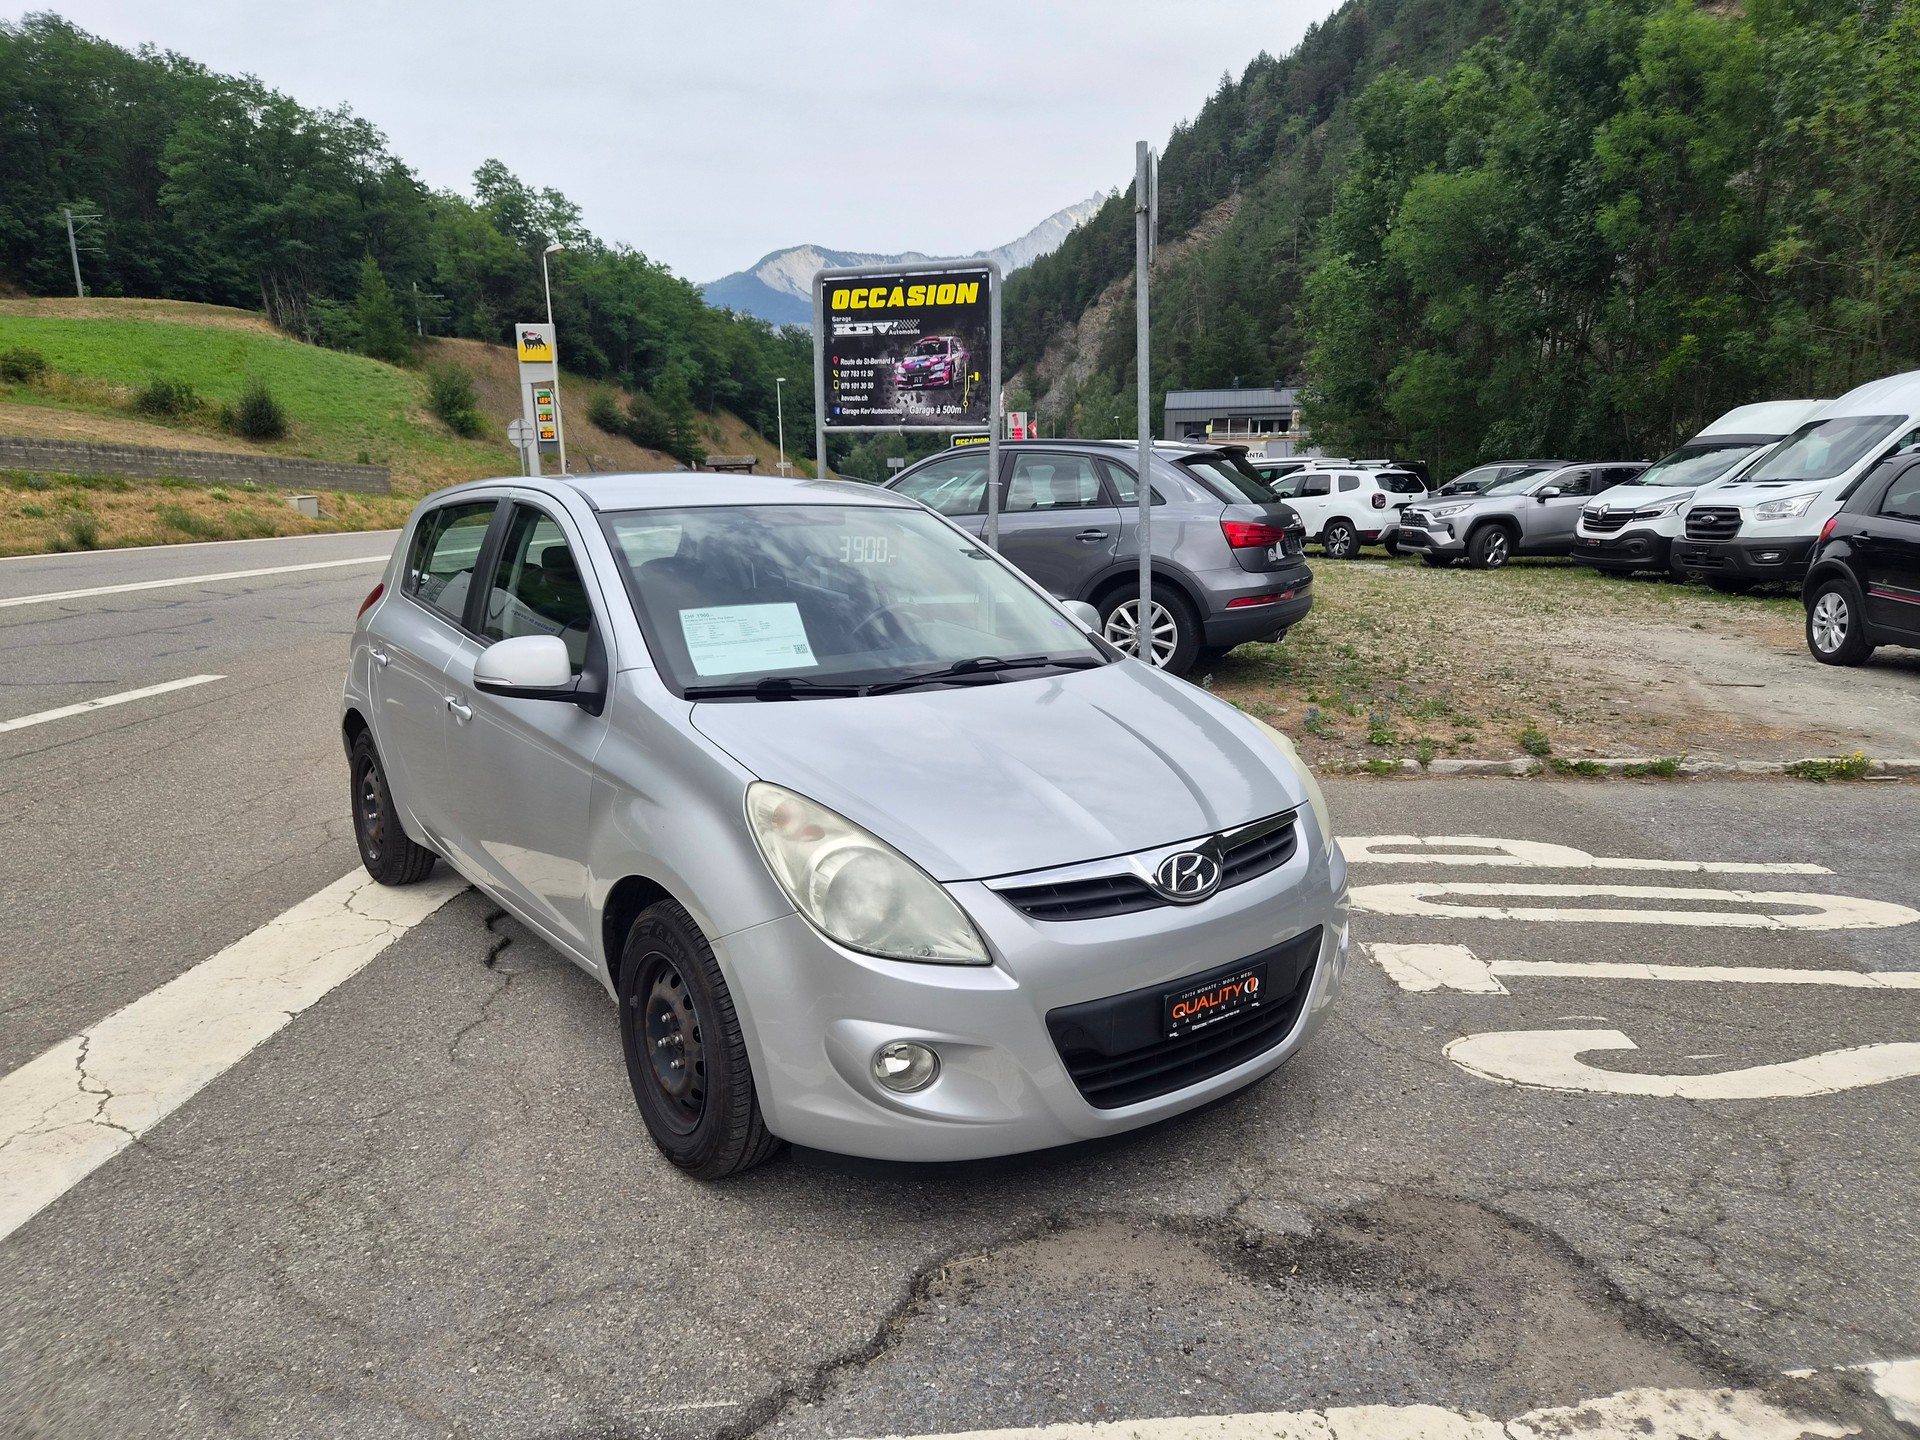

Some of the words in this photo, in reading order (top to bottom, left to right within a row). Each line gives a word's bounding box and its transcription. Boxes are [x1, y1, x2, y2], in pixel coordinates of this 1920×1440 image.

[831, 282, 979, 310] OCCASION
[841, 408, 860, 416] Garage
[909, 406, 934, 417] Garage
[936, 405, 941, 414] à
[942, 404, 962, 414] 500m
[1197, 983, 1217, 994] MONATE
[1222, 977, 1235, 985] MOIS
[1240, 971, 1252, 979] MESI
[1172, 982, 1244, 1019] QUALITY
[1172, 993, 1258, 1029] GARANTIE
